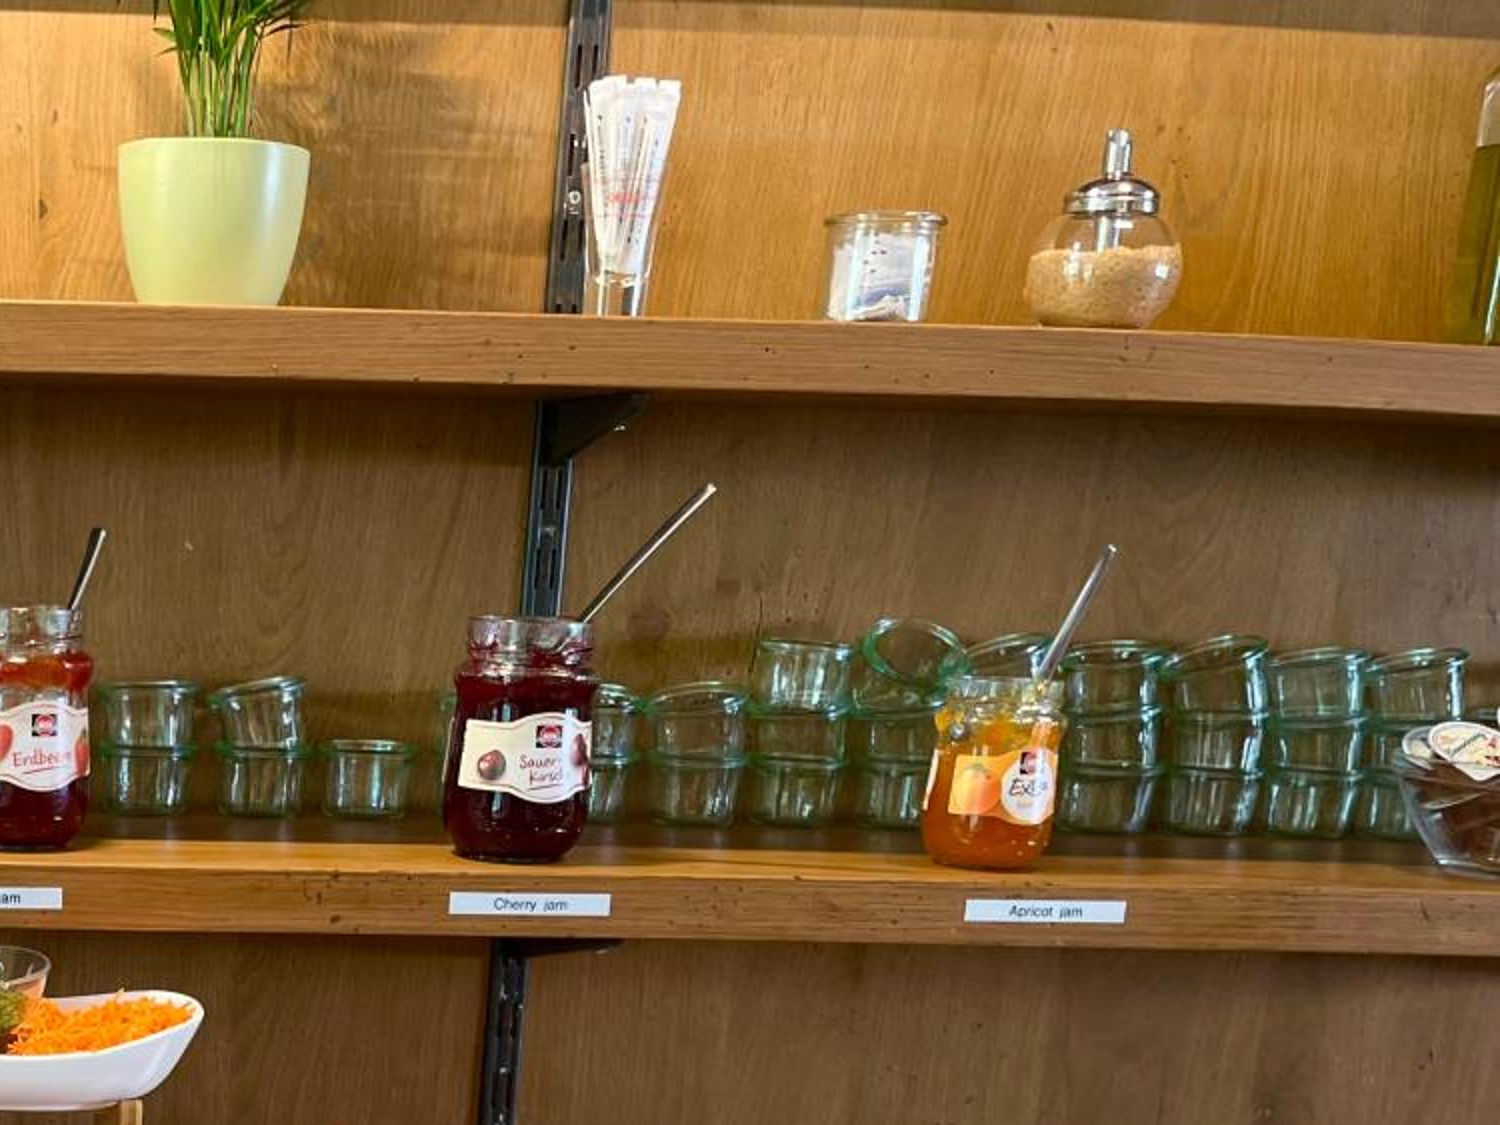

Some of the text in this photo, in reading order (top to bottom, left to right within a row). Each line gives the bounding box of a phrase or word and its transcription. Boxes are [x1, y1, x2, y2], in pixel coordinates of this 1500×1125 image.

[493, 897, 568, 913] Cherry jam
[1008, 904, 1083, 920] Apricot jam
